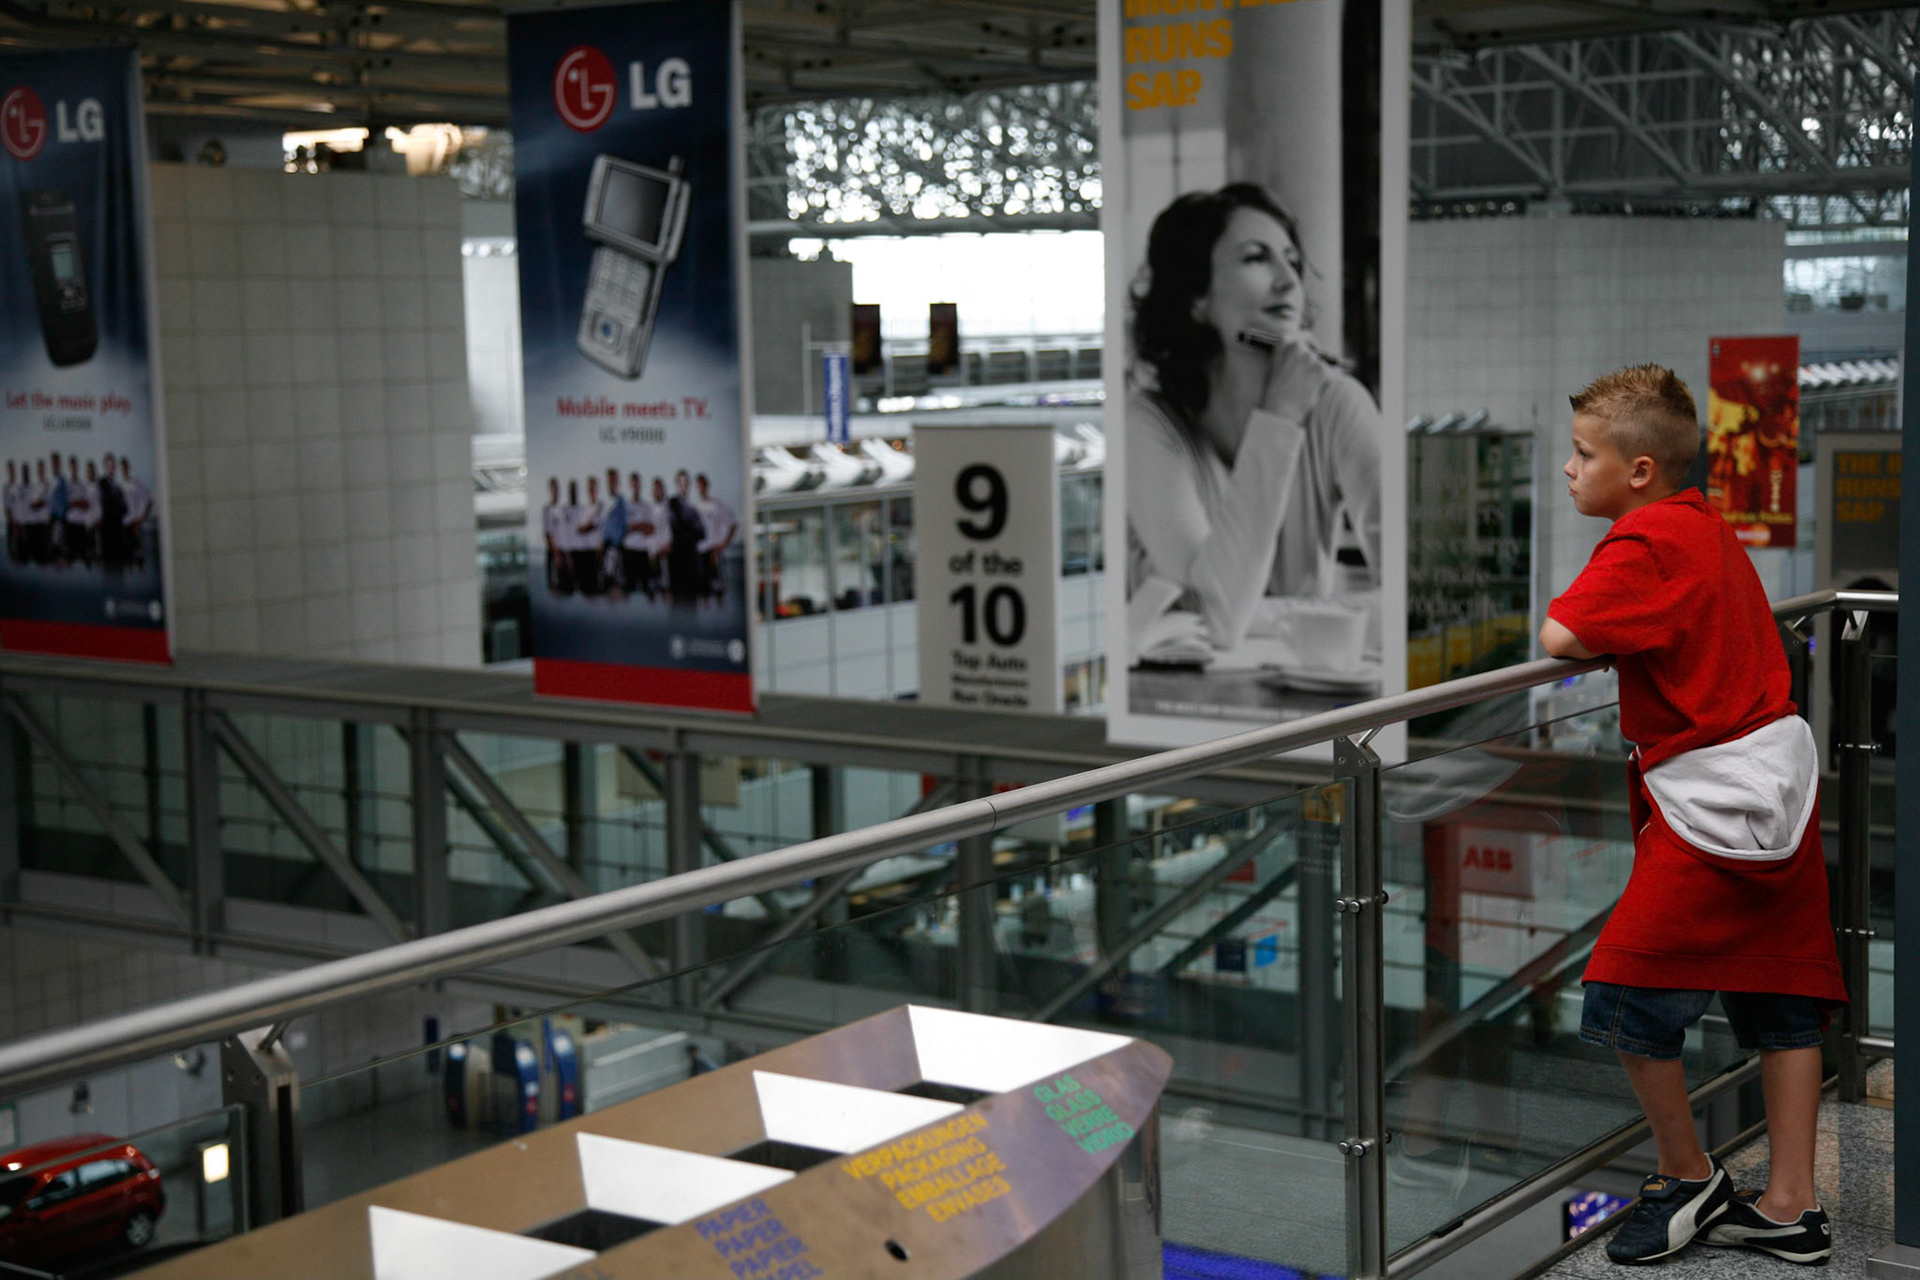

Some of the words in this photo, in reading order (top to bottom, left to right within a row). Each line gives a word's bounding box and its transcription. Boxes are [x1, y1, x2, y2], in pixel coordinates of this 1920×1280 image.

[1124, 18, 1233, 64] RUNS
[628, 57, 693, 110] LG
[56, 97, 104, 143] LG
[6, 387, 27, 410] Let
[31, 388, 54, 410] the
[58, 392, 96, 411] music
[556, 396, 617, 418] Mobile
[621, 400, 678, 419] meets
[1837, 452, 1881, 474] THE
[954, 462, 1008, 543] 9
[949, 551, 974, 575] of
[982, 552, 1024, 577] the
[949, 584, 1026, 649] 10
[952, 650, 981, 671] Top
[986, 652, 1028, 672] Auto
[1463, 844, 1513, 872] ABB
[1034, 1075, 1080, 1103] GLAS
[1045, 1089, 1101, 1121] GLASS
[1060, 1105, 1119, 1138] VERRE
[1076, 1121, 1134, 1154] VIDRIO
[840, 1112, 989, 1180] VERPACKUNGEN
[880, 1136, 987, 1191] PACKAGING
[896, 1152, 1007, 1211] EMBALLAGE
[925, 1175, 1011, 1223] ENVASES
[694, 1199, 774, 1239] PAPIER
[714, 1218, 789, 1258] PAPER
[729, 1237, 810, 1280] PAPIER
